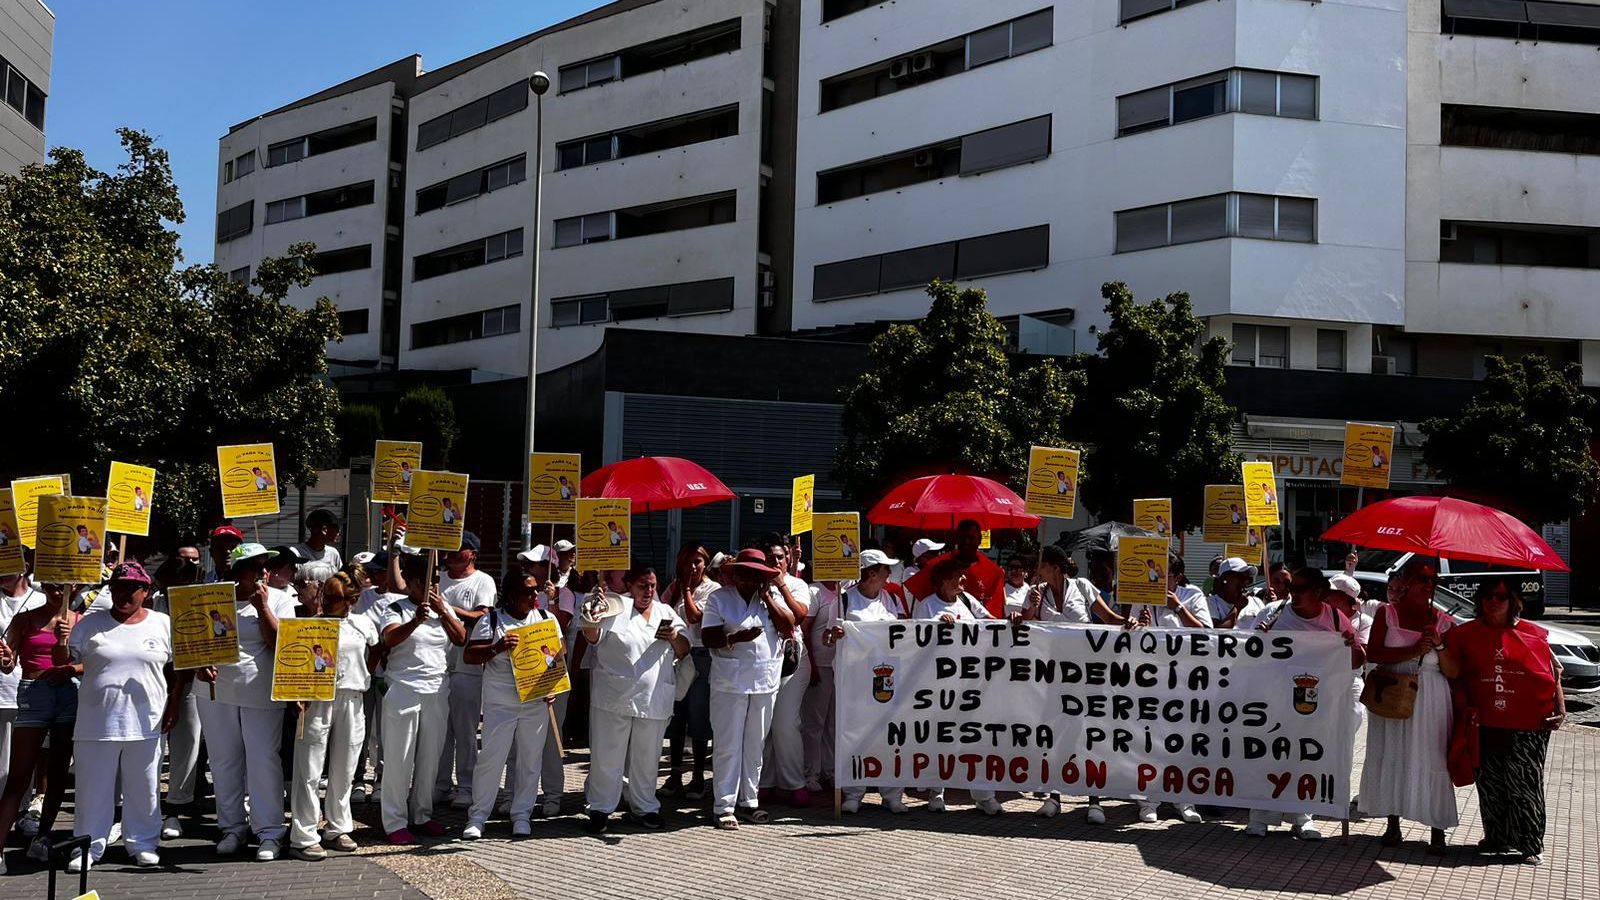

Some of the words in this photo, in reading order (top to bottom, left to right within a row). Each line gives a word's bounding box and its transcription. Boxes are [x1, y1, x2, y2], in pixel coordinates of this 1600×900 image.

[1377, 526, 1404, 536] U.G.T.
[888, 624, 1031, 649] FUENTE
[1085, 629, 1294, 660] VAQUEROS
[913, 689, 982, 712] SUS
[1061, 694, 1281, 733] DERECHOS,
[887, 719, 1054, 749] NUESTRA
[1137, 763, 1235, 798] PAGA
